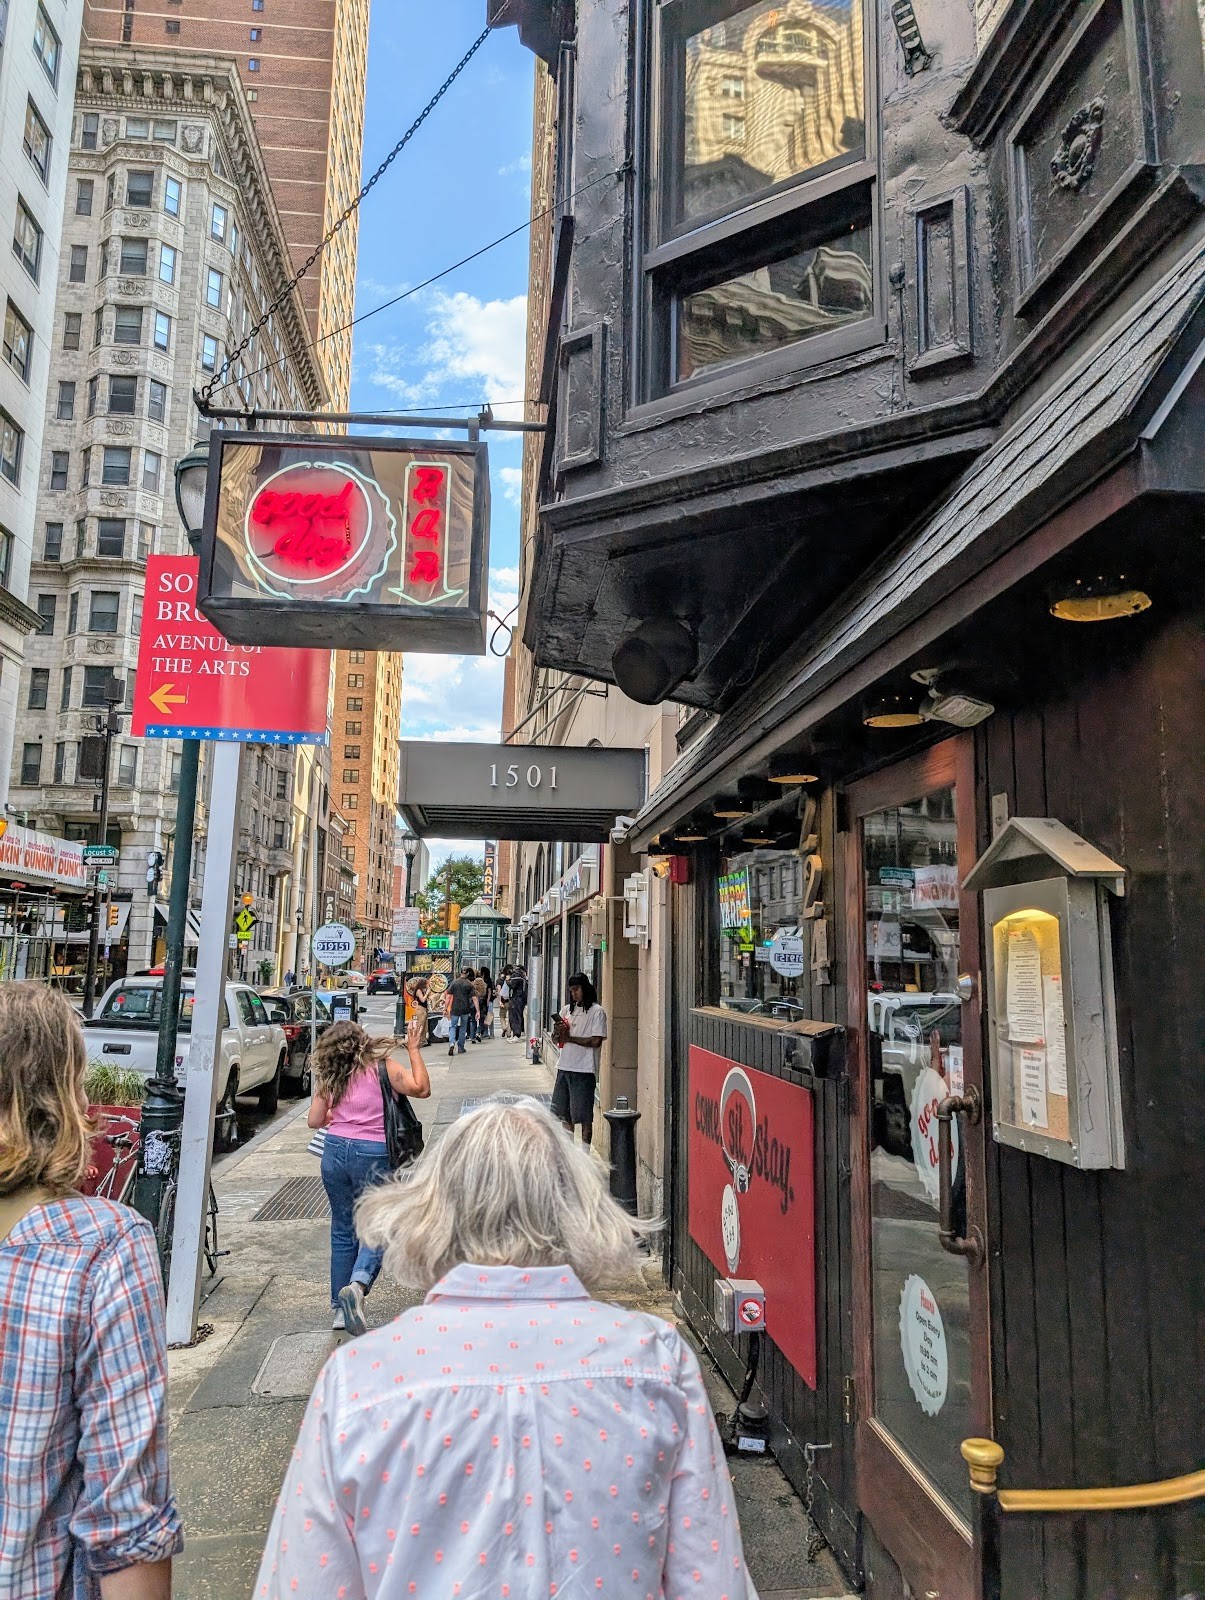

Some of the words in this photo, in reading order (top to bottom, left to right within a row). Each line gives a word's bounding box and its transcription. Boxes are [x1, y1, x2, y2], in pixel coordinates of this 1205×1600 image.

[158, 572, 199, 593] SO
[152, 657, 192, 674] THE
[197, 659, 250, 677] ARTS
[488, 763, 559, 789] 1501
[84, 849, 106, 857] Locust
[484, 857, 494, 895] PARK
[317, 942, 350, 951] 919151
[915, 1310, 927, 1327] Open
[927, 1319, 940, 1339] Every
[923, 1331, 933, 1348] Day
